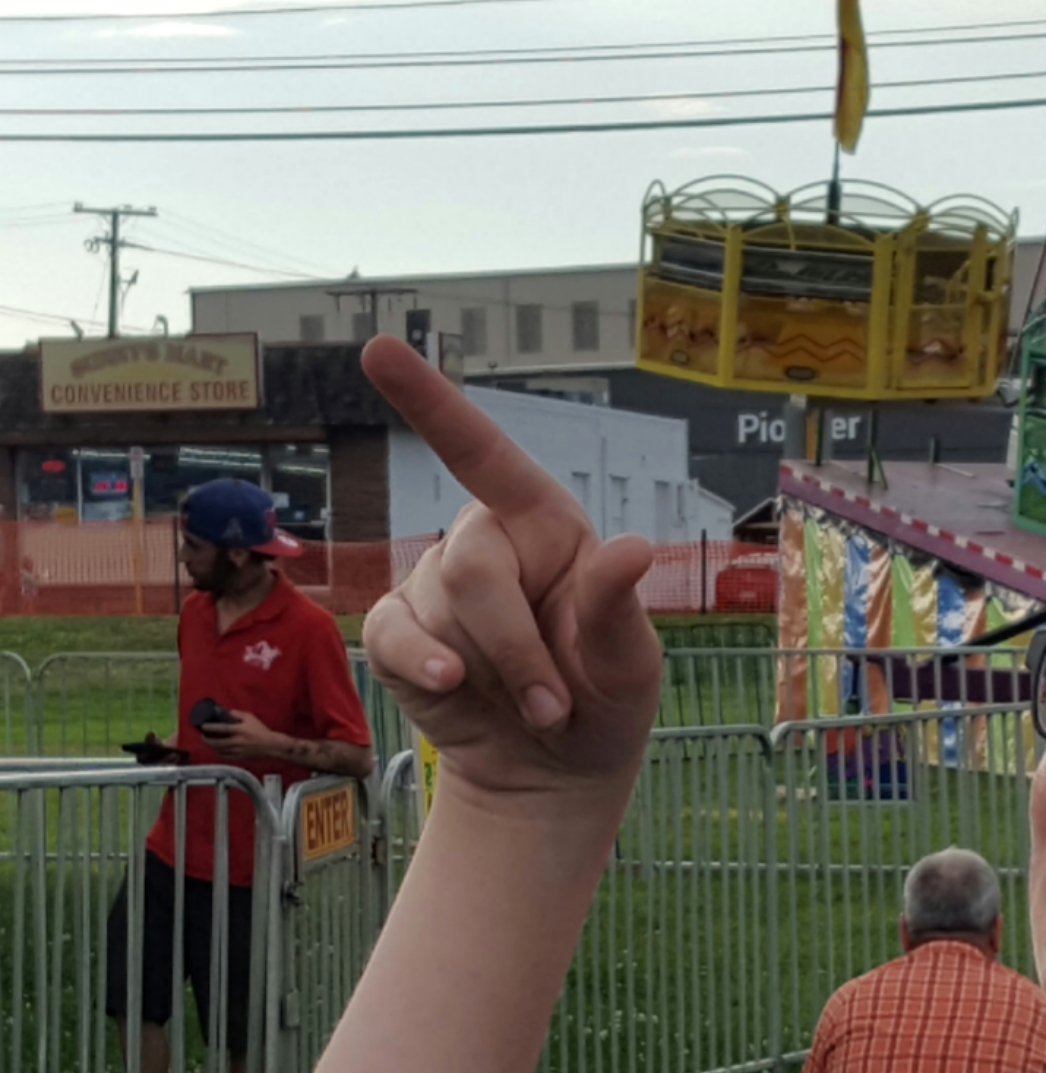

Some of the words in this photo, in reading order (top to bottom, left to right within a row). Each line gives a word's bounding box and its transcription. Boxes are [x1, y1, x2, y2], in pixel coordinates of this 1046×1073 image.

[51, 380, 181, 404] CONVENIENCE
[190, 380, 249, 401] STORE
[737, 410, 861, 444] Pioer
[306, 789, 350, 850] ENTER
